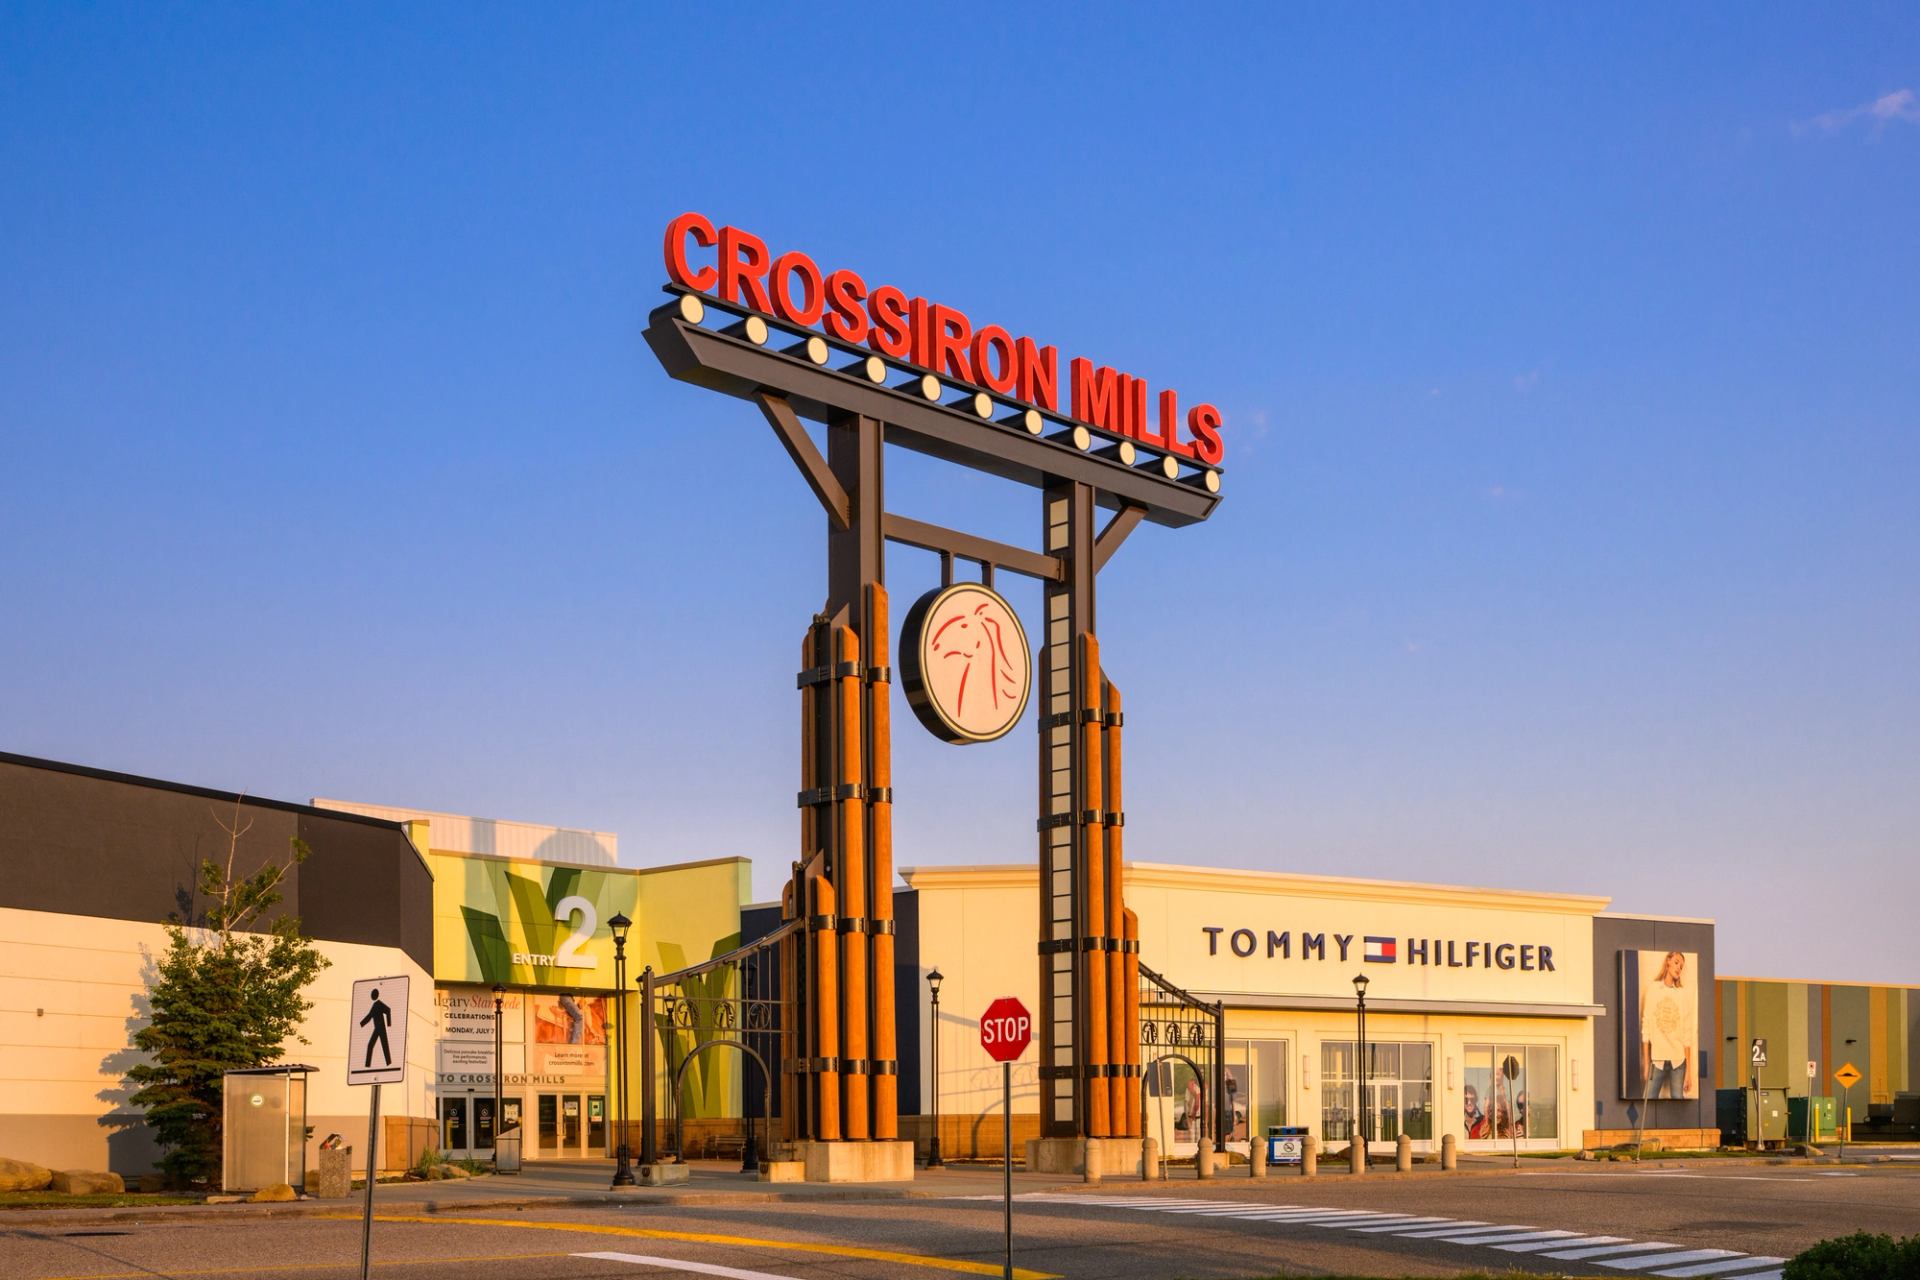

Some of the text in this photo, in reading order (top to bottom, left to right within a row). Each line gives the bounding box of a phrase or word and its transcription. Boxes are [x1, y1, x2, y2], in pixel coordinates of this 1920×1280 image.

[664, 212, 1225, 465] CROSSIRON MILLS
[512, 895, 598, 969] ENTRY 2
[1202, 927, 1556, 972] TOMMY HILFIGER
[470, 994, 520, 1009] Stamede
[444, 1013, 495, 1021] CELEBRATIONS
[983, 1016, 1029, 1044] STOP
[440, 1074, 565, 1084] TO CROSSRON MILLS
